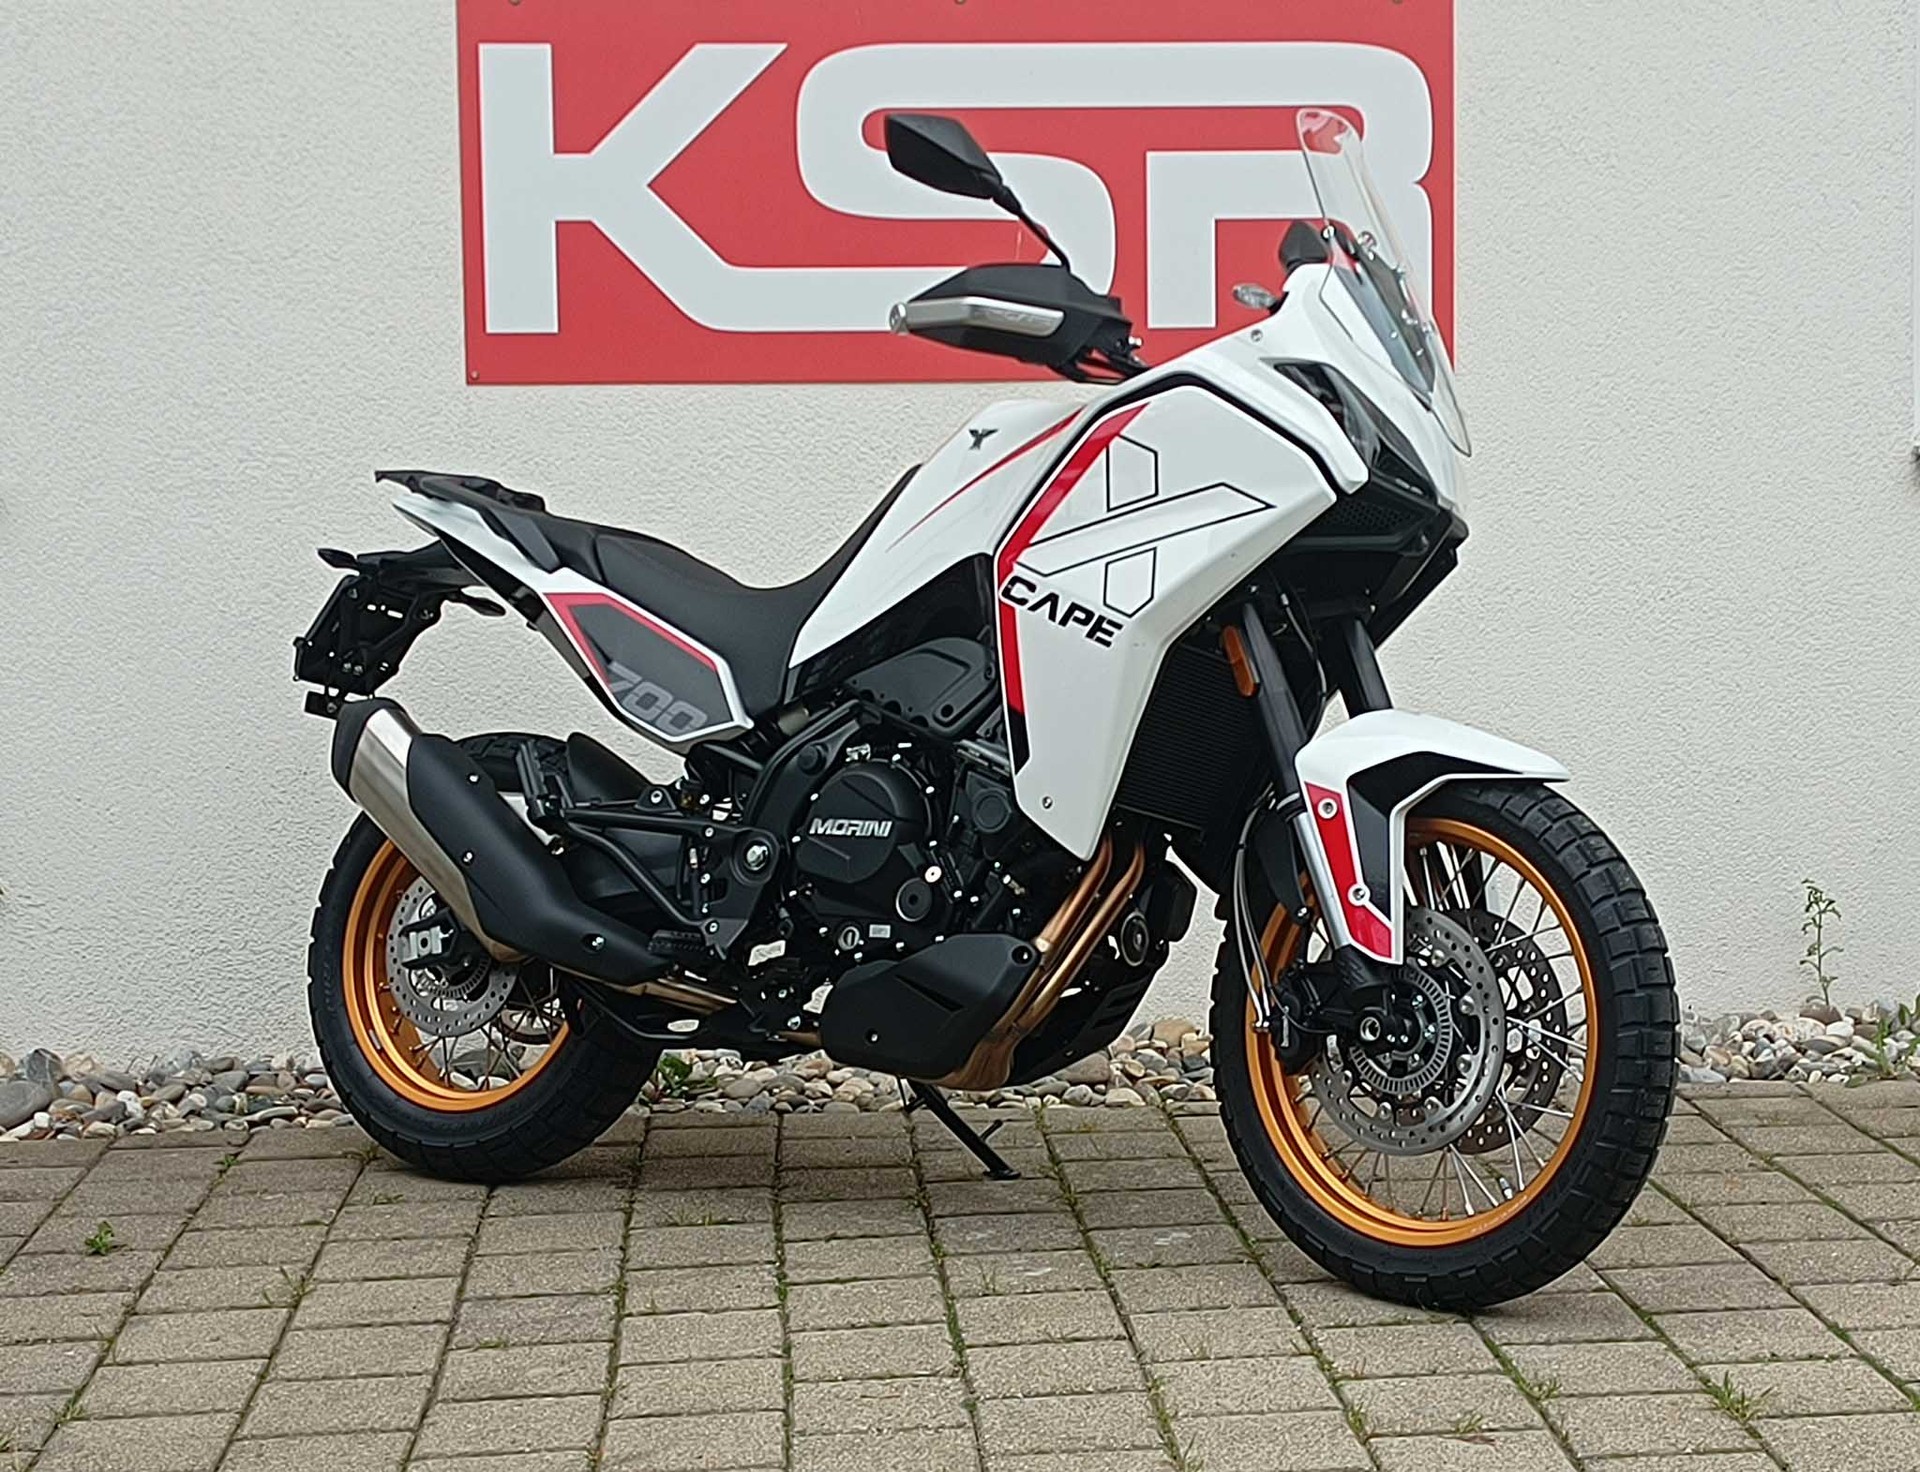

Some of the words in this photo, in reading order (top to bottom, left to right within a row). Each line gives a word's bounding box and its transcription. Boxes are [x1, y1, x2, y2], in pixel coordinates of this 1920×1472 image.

[478, 42, 1433, 334] KSR
[1001, 575, 1123, 648] CAPE
[607, 661, 708, 735] 700
[809, 818, 893, 837] MORINI
